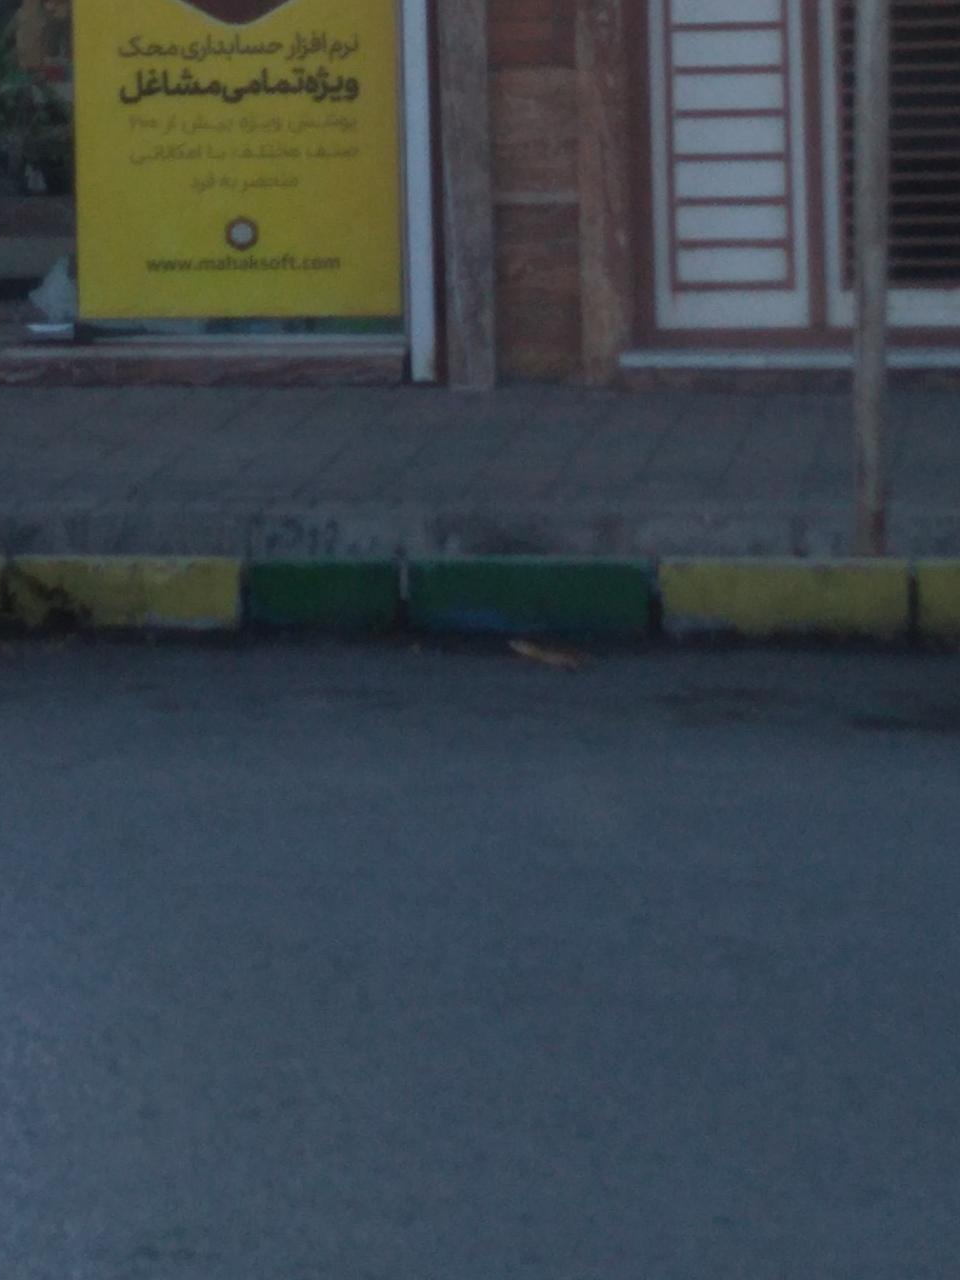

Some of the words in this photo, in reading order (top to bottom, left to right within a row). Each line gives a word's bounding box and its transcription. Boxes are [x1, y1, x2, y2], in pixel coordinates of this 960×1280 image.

[117, 35, 179, 59] محک
[181, 34, 284, 63] حسابداری
[285, 31, 327, 62] افزار
[328, 32, 360, 61] نرم
[119, 67, 221, 105] مشاغل
[221, 68, 306, 104] تمامی
[306, 66, 360, 103] ویژه
